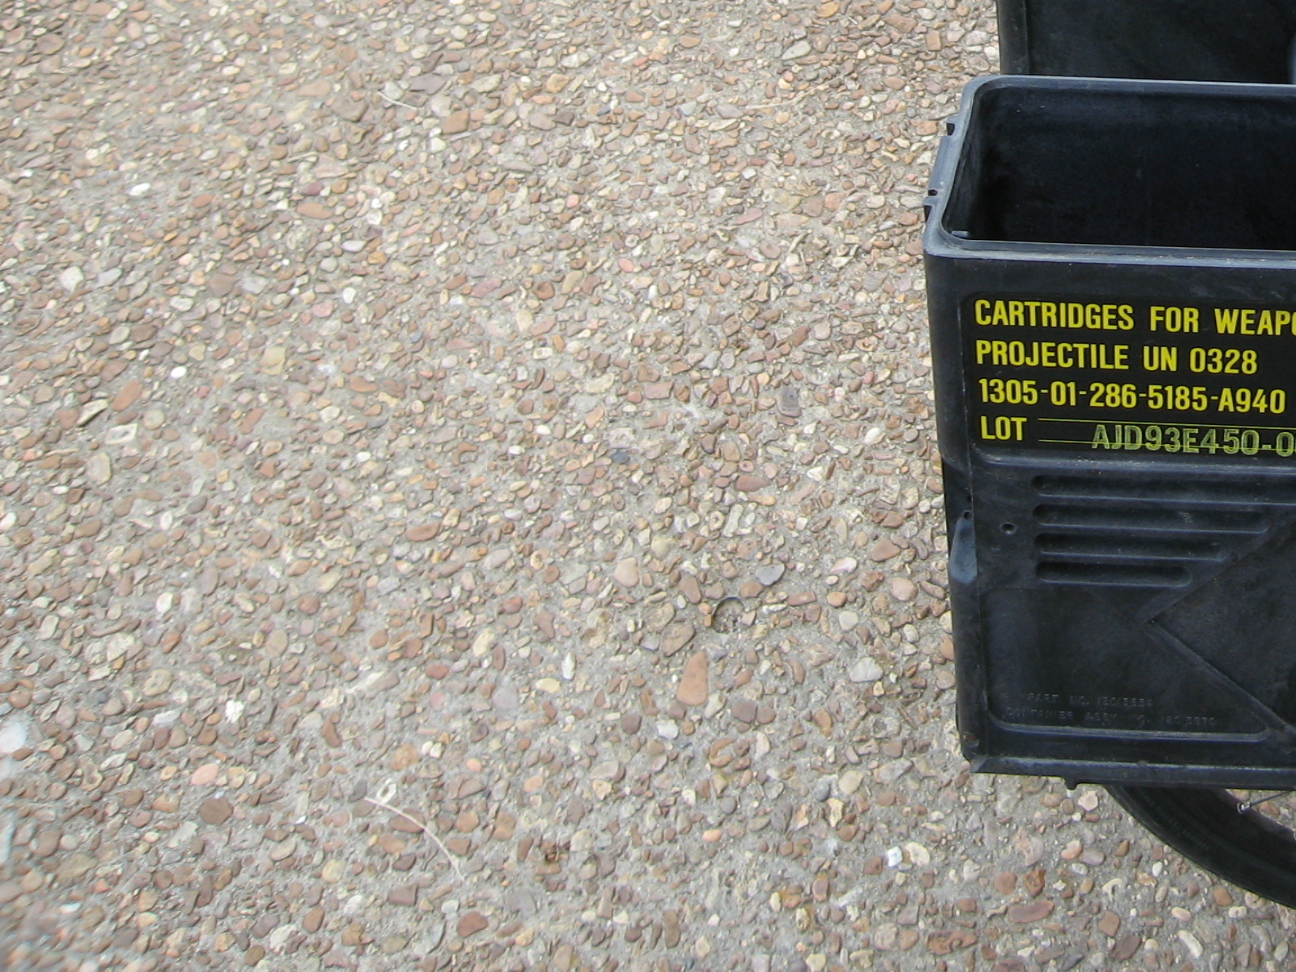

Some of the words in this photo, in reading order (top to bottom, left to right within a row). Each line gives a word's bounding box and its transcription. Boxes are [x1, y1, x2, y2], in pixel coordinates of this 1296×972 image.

[975, 299, 1135, 331] CARTRIDGES
[1150, 305, 1199, 333] FOR
[975, 339, 1130, 370] PROJECTILE
[1143, 345, 1178, 372] UN
[1189, 347, 1258, 375] 0328
[978, 378, 1286, 414] 1305-01-286-5185-A940
[980, 415, 1028, 441] LOT
